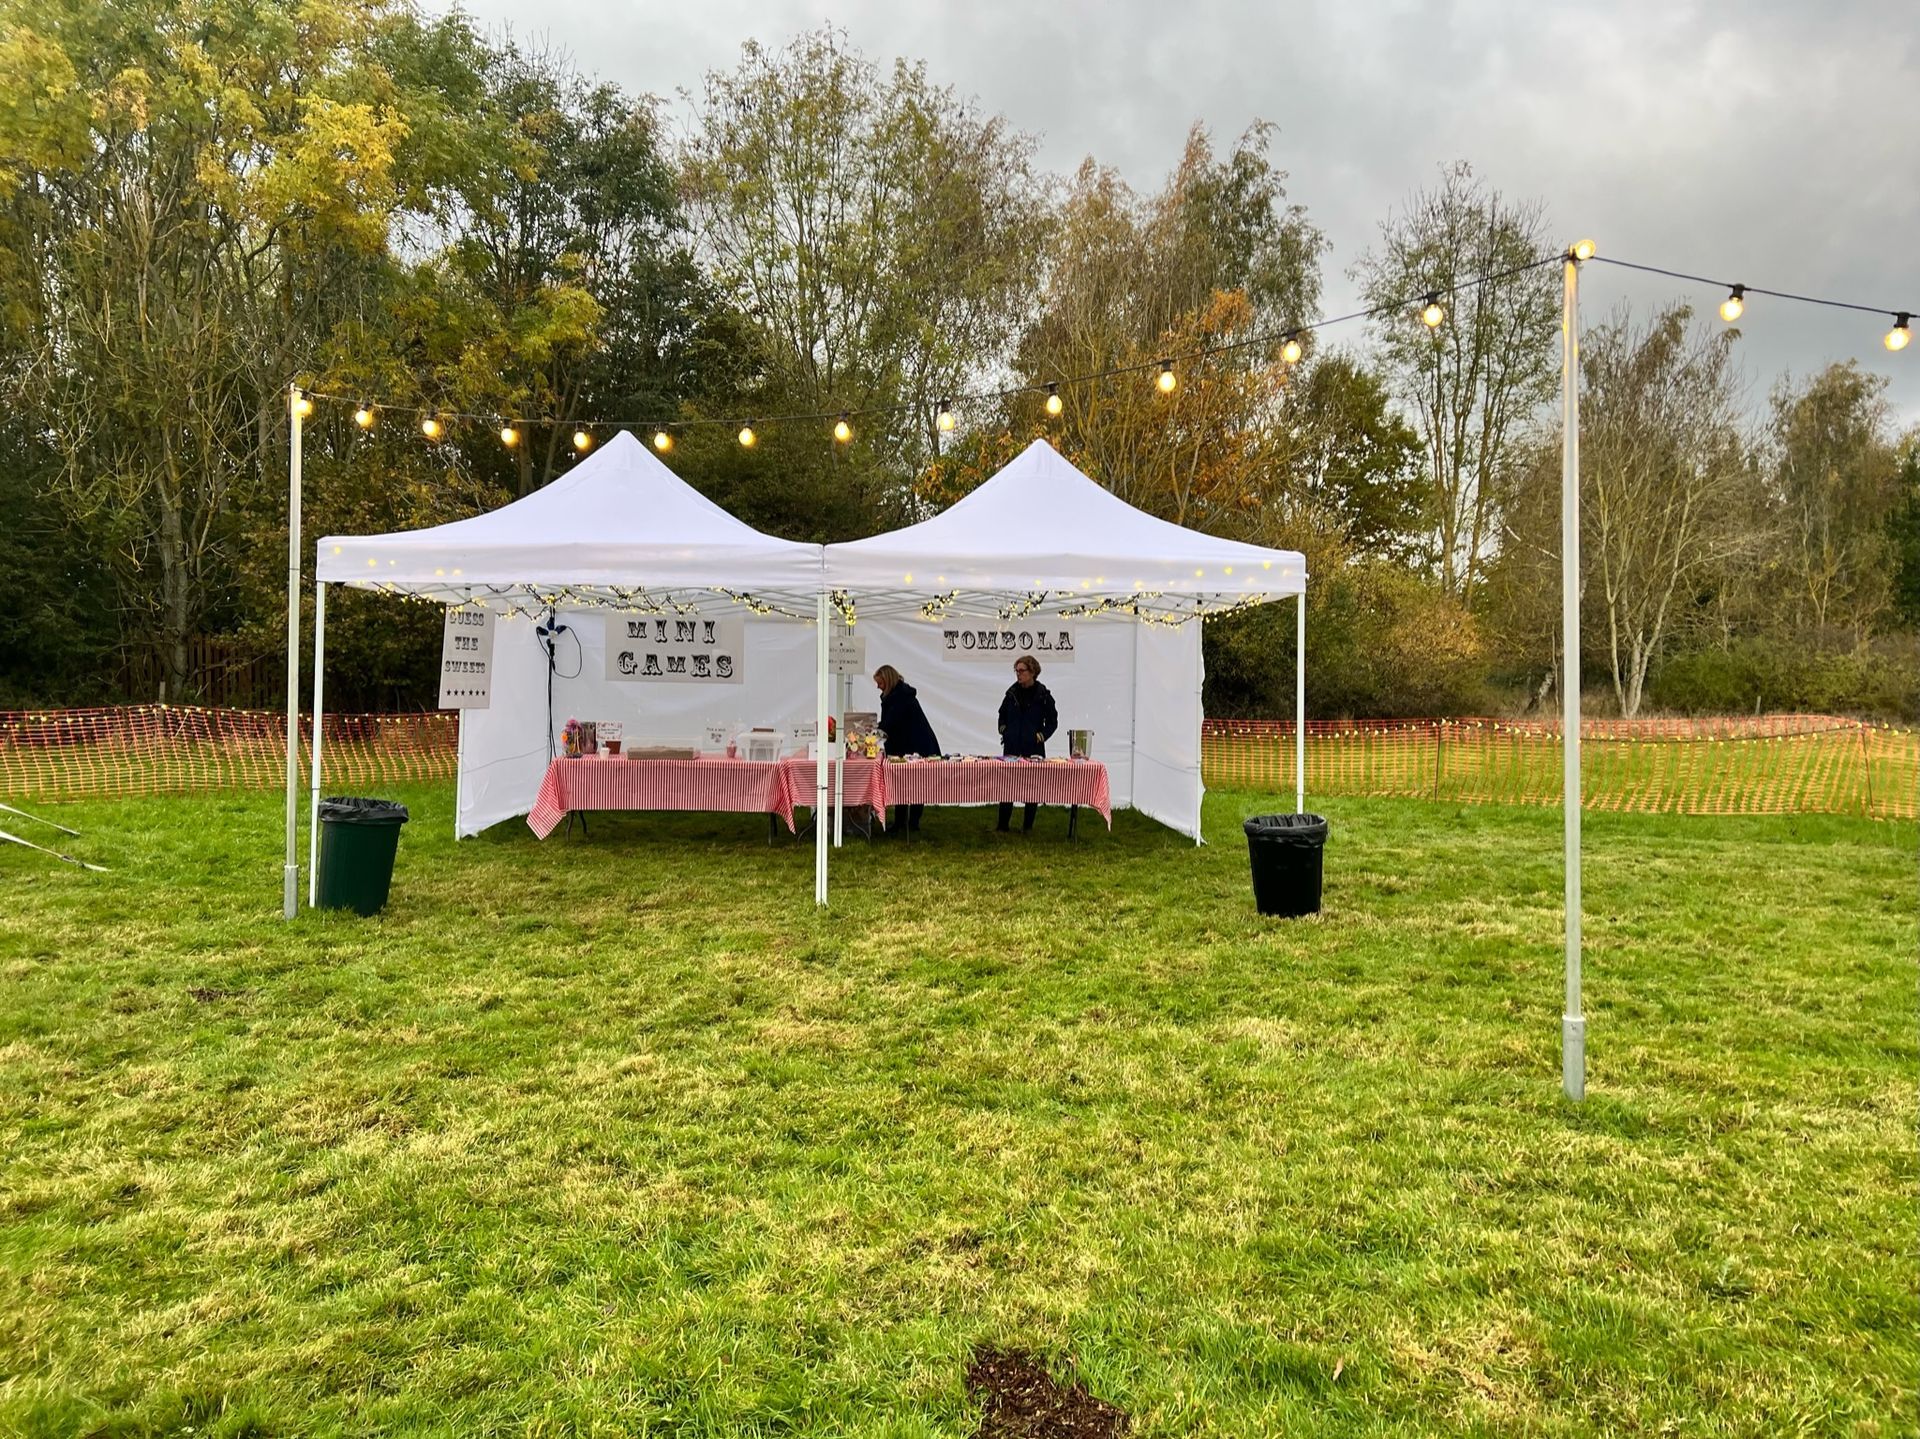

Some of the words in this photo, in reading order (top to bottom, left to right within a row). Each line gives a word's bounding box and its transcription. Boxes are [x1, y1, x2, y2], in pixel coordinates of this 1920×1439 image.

[627, 619, 716, 644] MINI
[943, 630, 1074, 650] TOMBOLA
[455, 636, 479, 651] THE
[445, 660, 486, 674] SWEETS
[617, 651, 733, 678] GAMES
